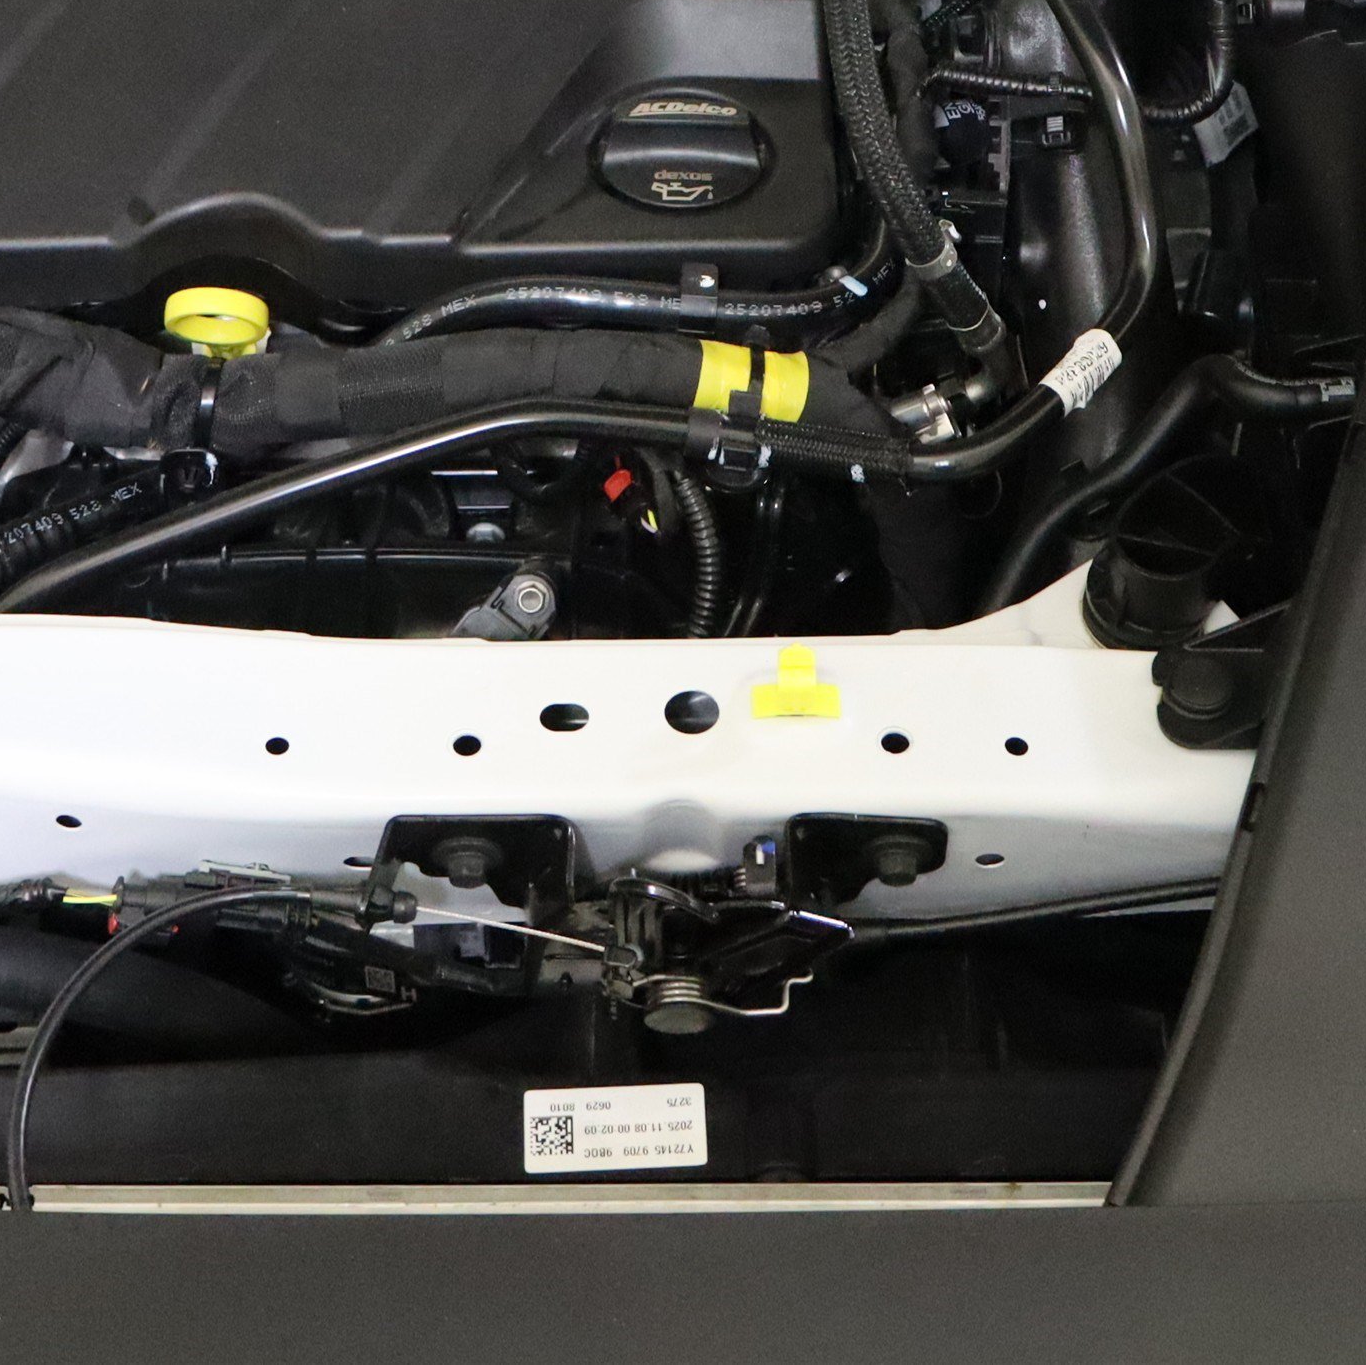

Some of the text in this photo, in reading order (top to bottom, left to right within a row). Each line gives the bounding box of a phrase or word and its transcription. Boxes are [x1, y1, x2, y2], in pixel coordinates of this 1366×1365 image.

[628, 101, 738, 117] ACDelco
[653, 169, 714, 181] dexos
[440, 294, 477, 317] MEX
[659, 295, 682, 311] ME
[724, 300, 823, 317] 25207409
[110, 482, 143, 505] MEX
[549, 1096, 692, 1112] 3275 0629 8010
[623, 1146, 649, 1156] 9709
[654, 1143, 694, 1156] Y72145
